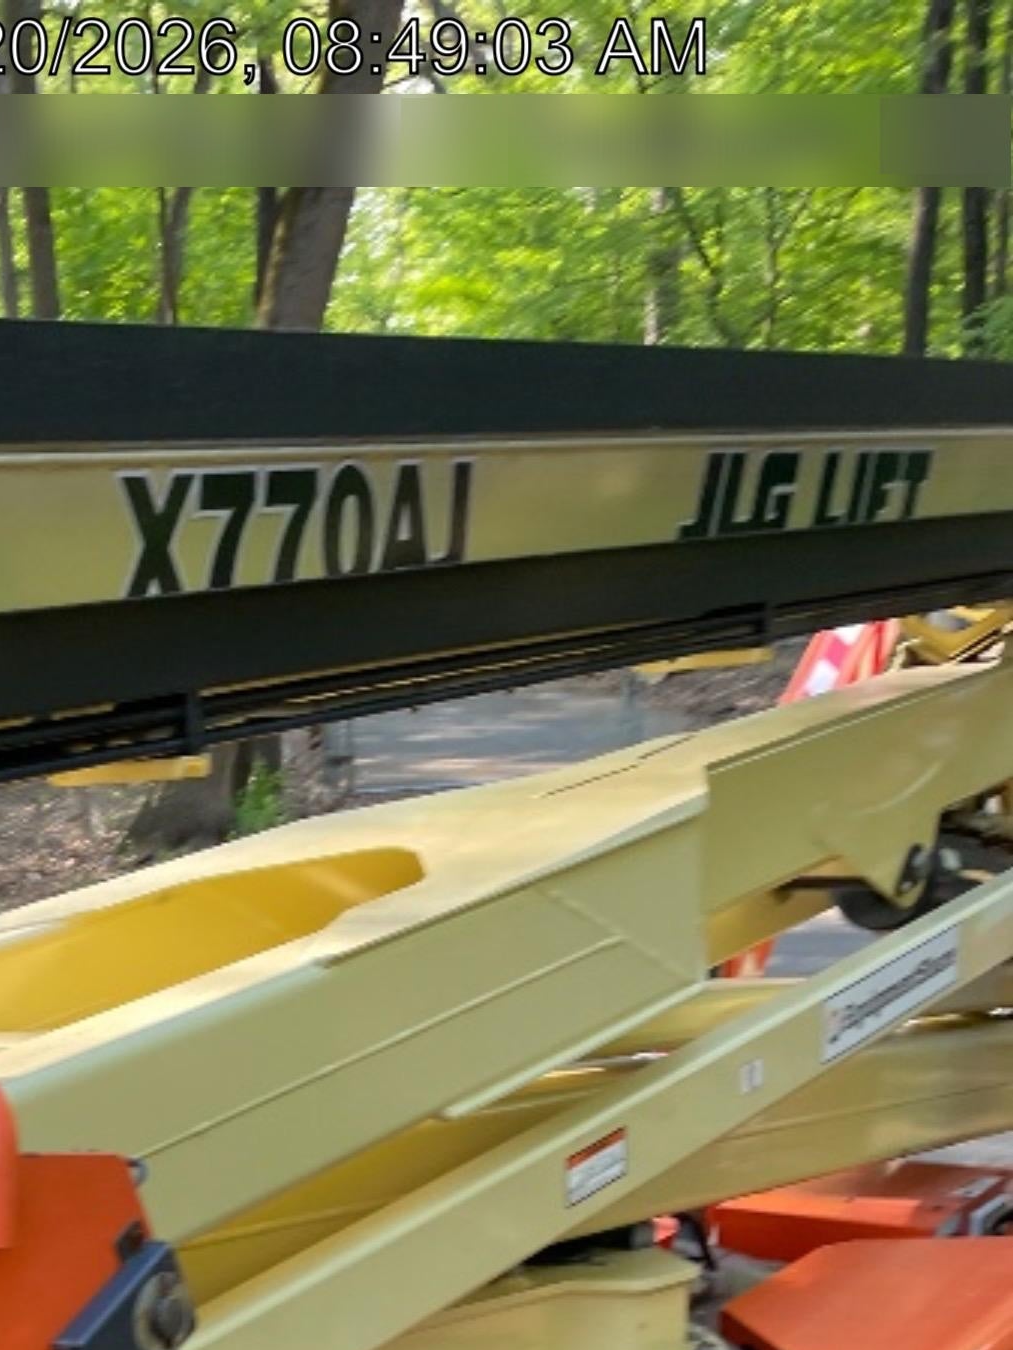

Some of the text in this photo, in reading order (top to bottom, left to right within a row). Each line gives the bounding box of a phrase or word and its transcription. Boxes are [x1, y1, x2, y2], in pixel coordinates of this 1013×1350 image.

[118, 458, 474, 599] X770AJ
[676, 448, 933, 538] JLG LIFT
